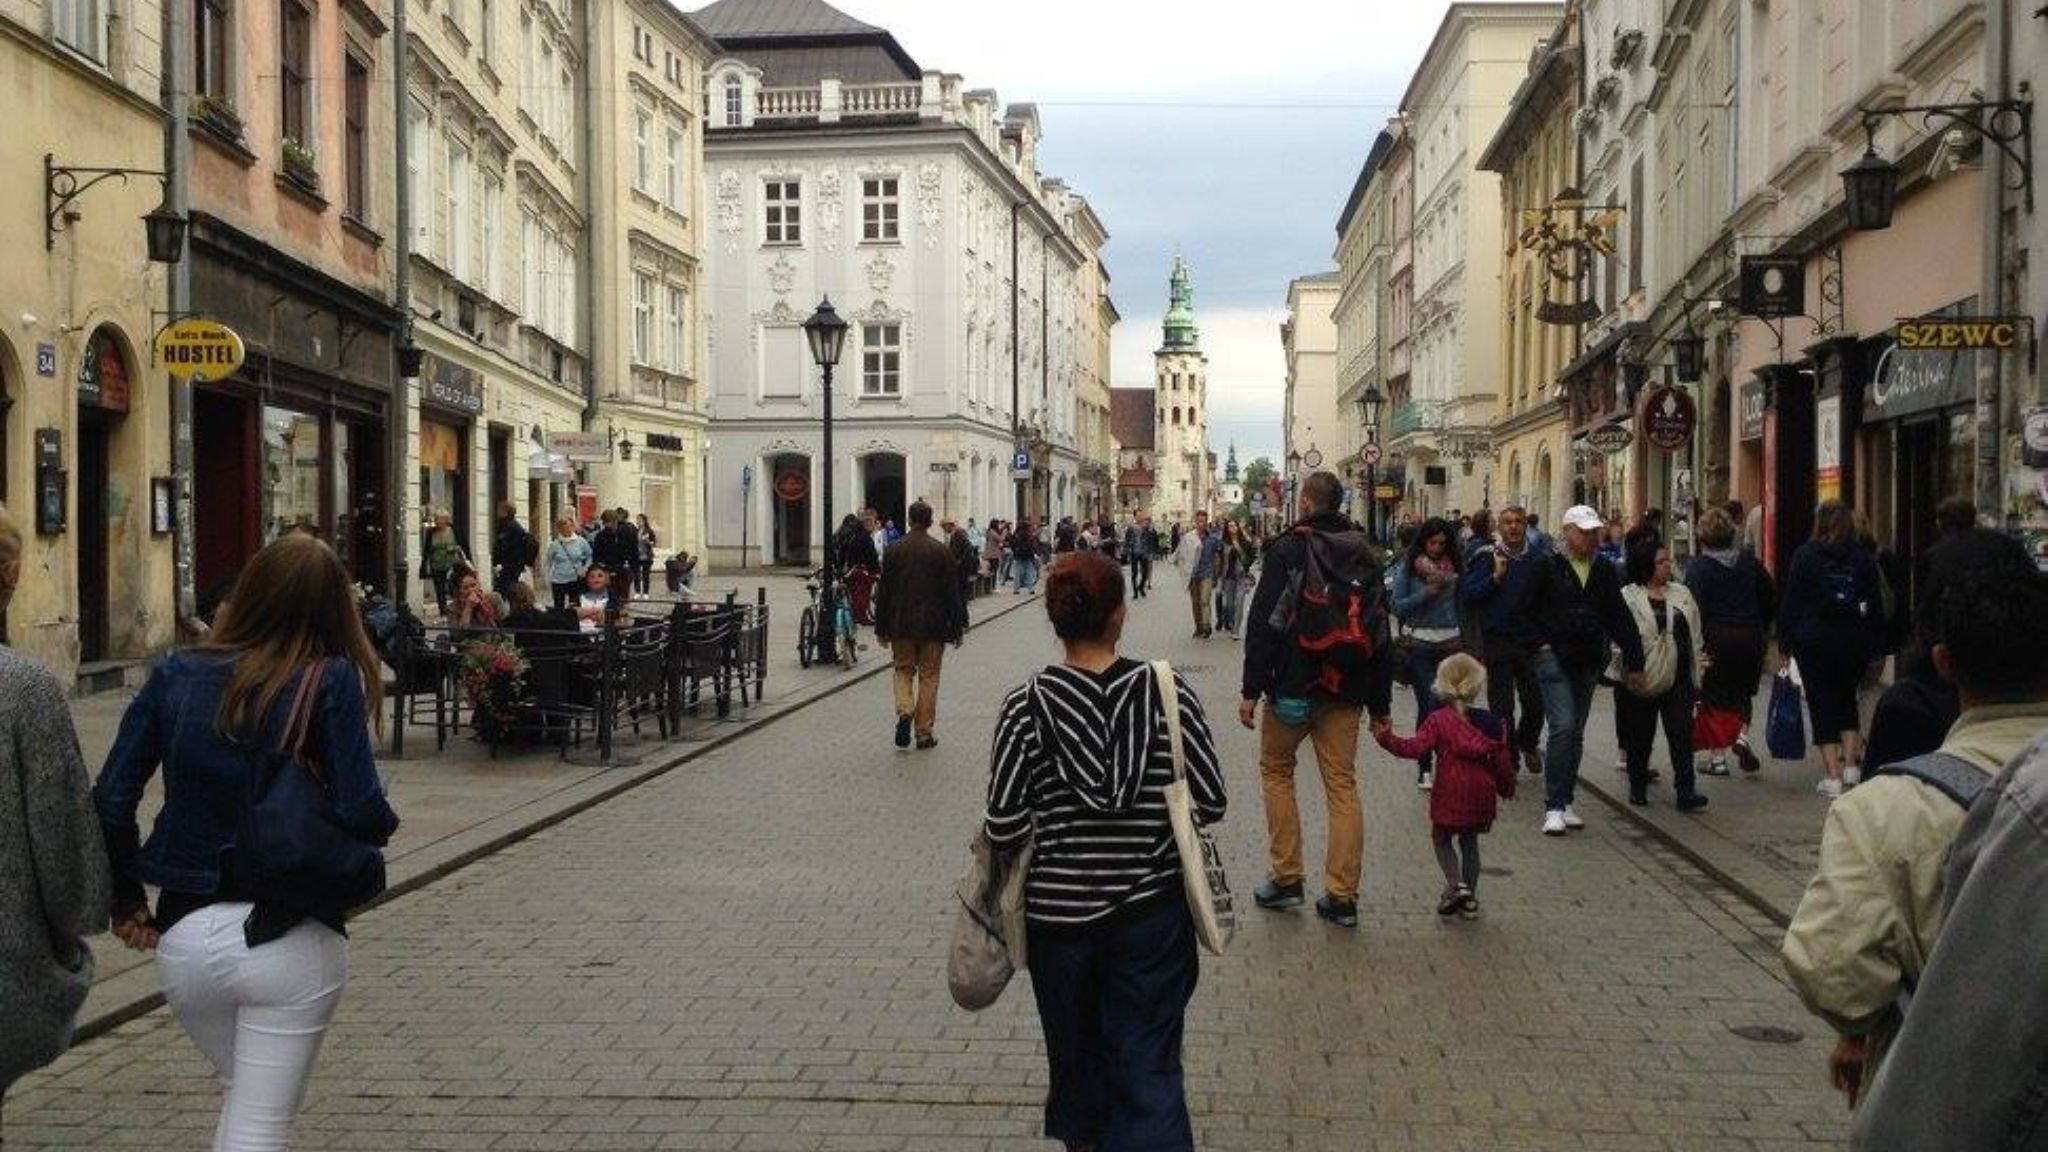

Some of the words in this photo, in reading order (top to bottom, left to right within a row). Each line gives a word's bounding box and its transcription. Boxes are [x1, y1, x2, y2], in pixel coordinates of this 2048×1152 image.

[1900, 324, 2014, 346] SZEWC
[39, 354, 54, 373] 34
[164, 345, 234, 364] HOSTEL
